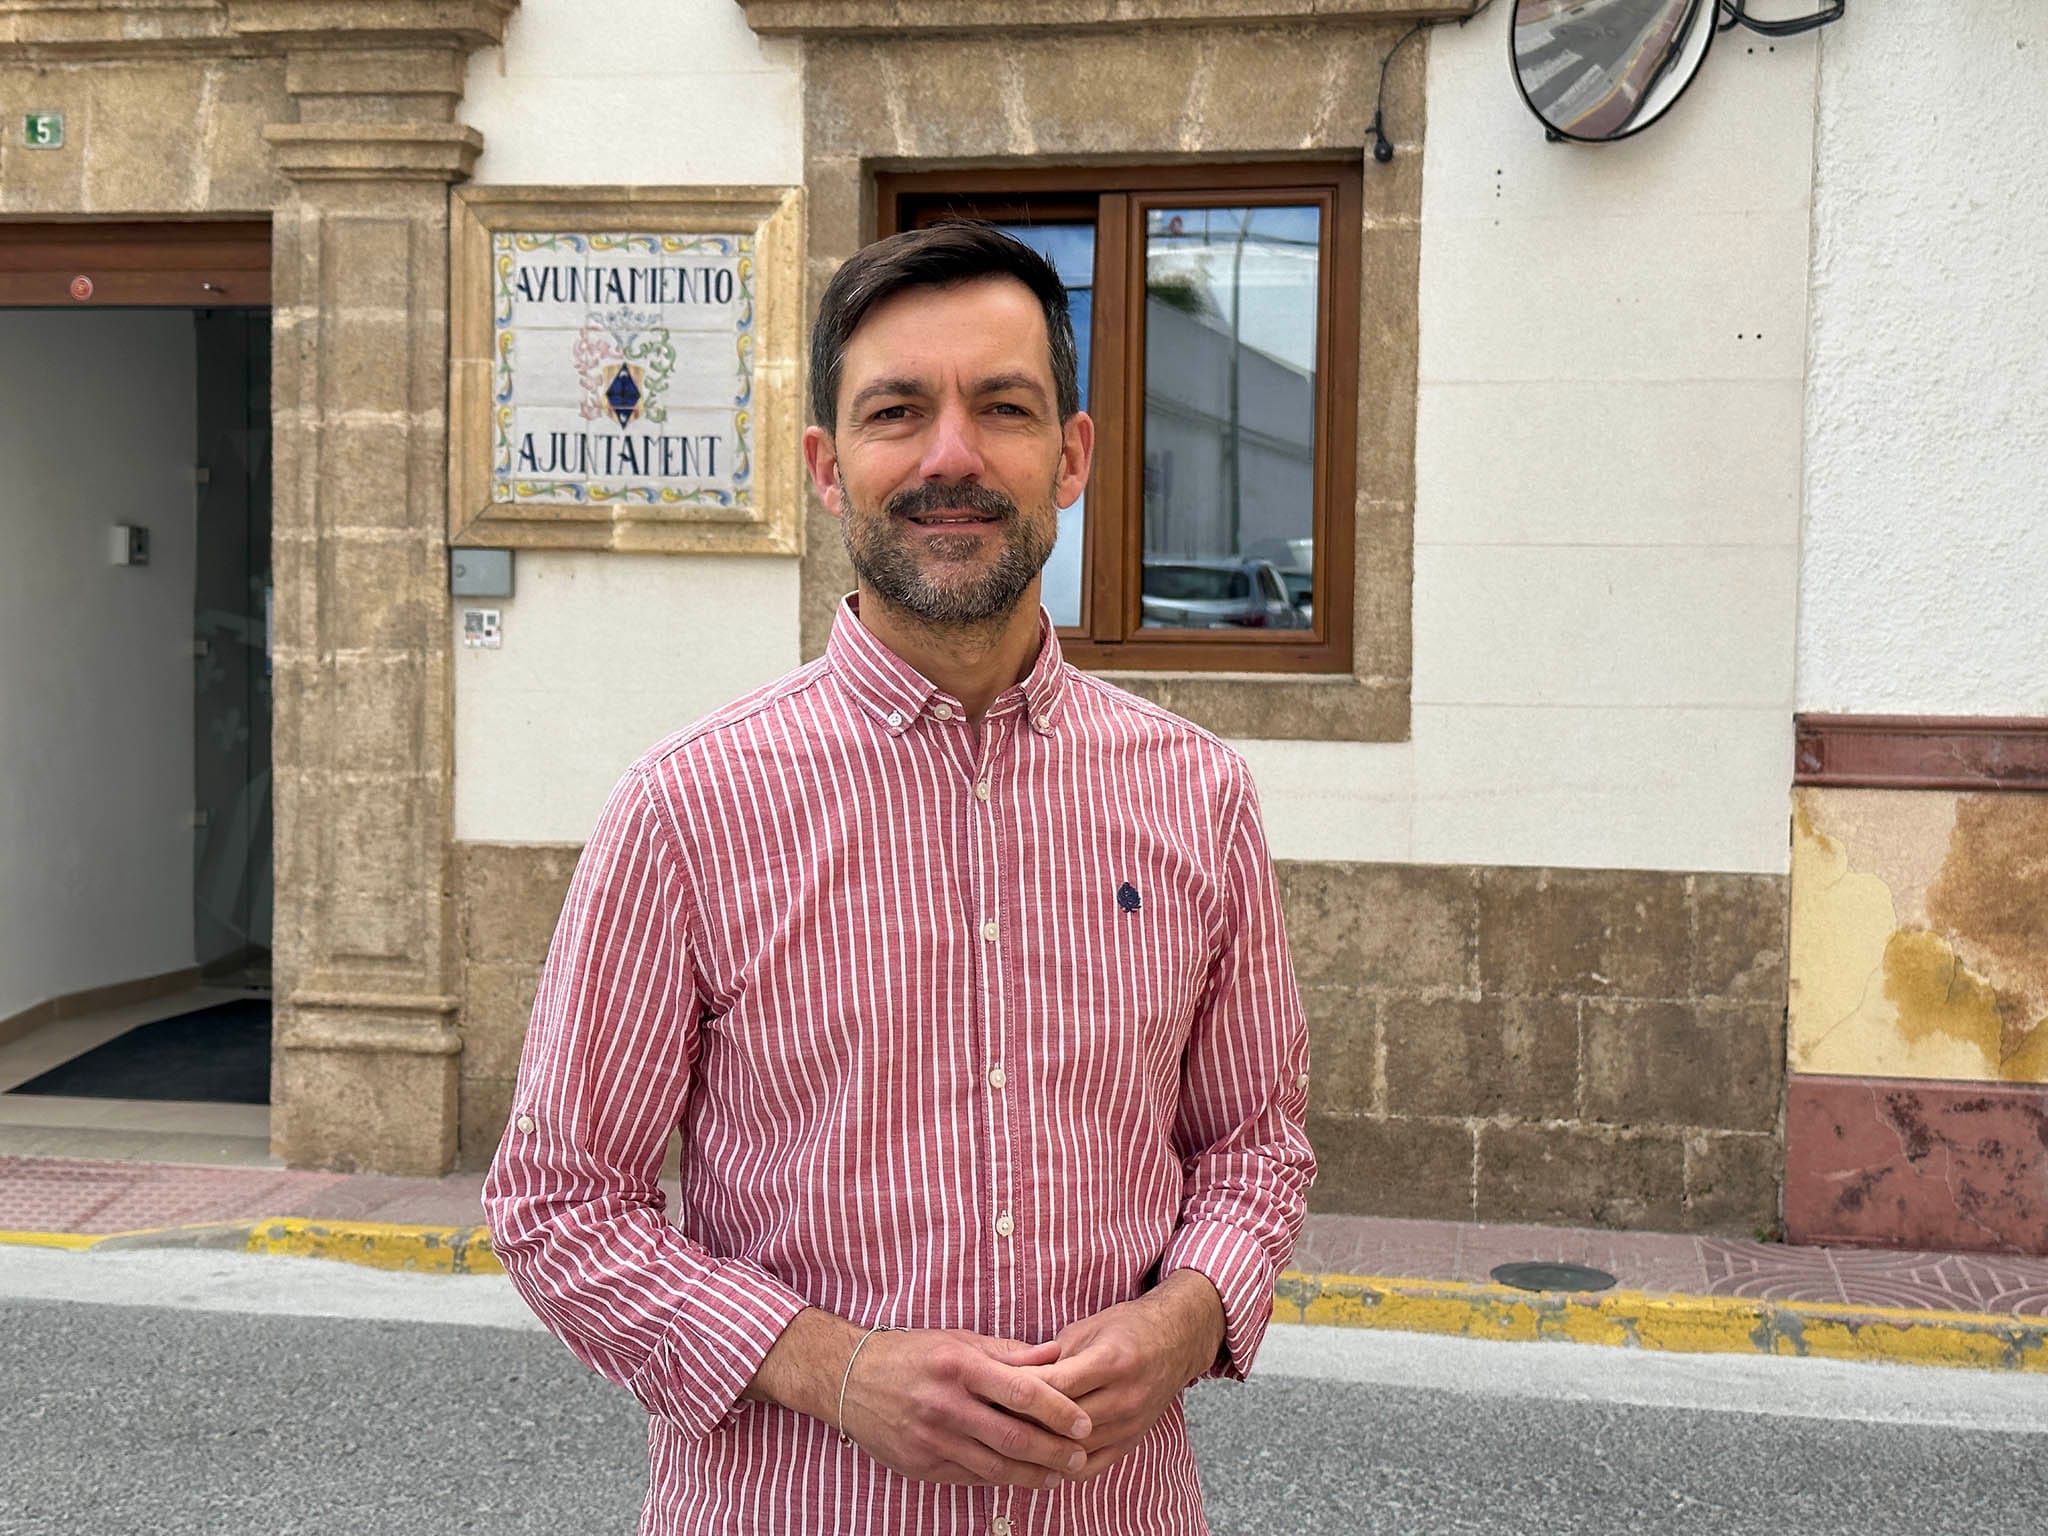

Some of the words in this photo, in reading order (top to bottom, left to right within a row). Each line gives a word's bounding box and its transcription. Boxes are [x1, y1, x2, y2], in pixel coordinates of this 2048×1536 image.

[37, 116, 50, 143] 5
[515, 266, 733, 303] AYUNTAMIENTO
[518, 433, 721, 476] AJUNTAMENT
